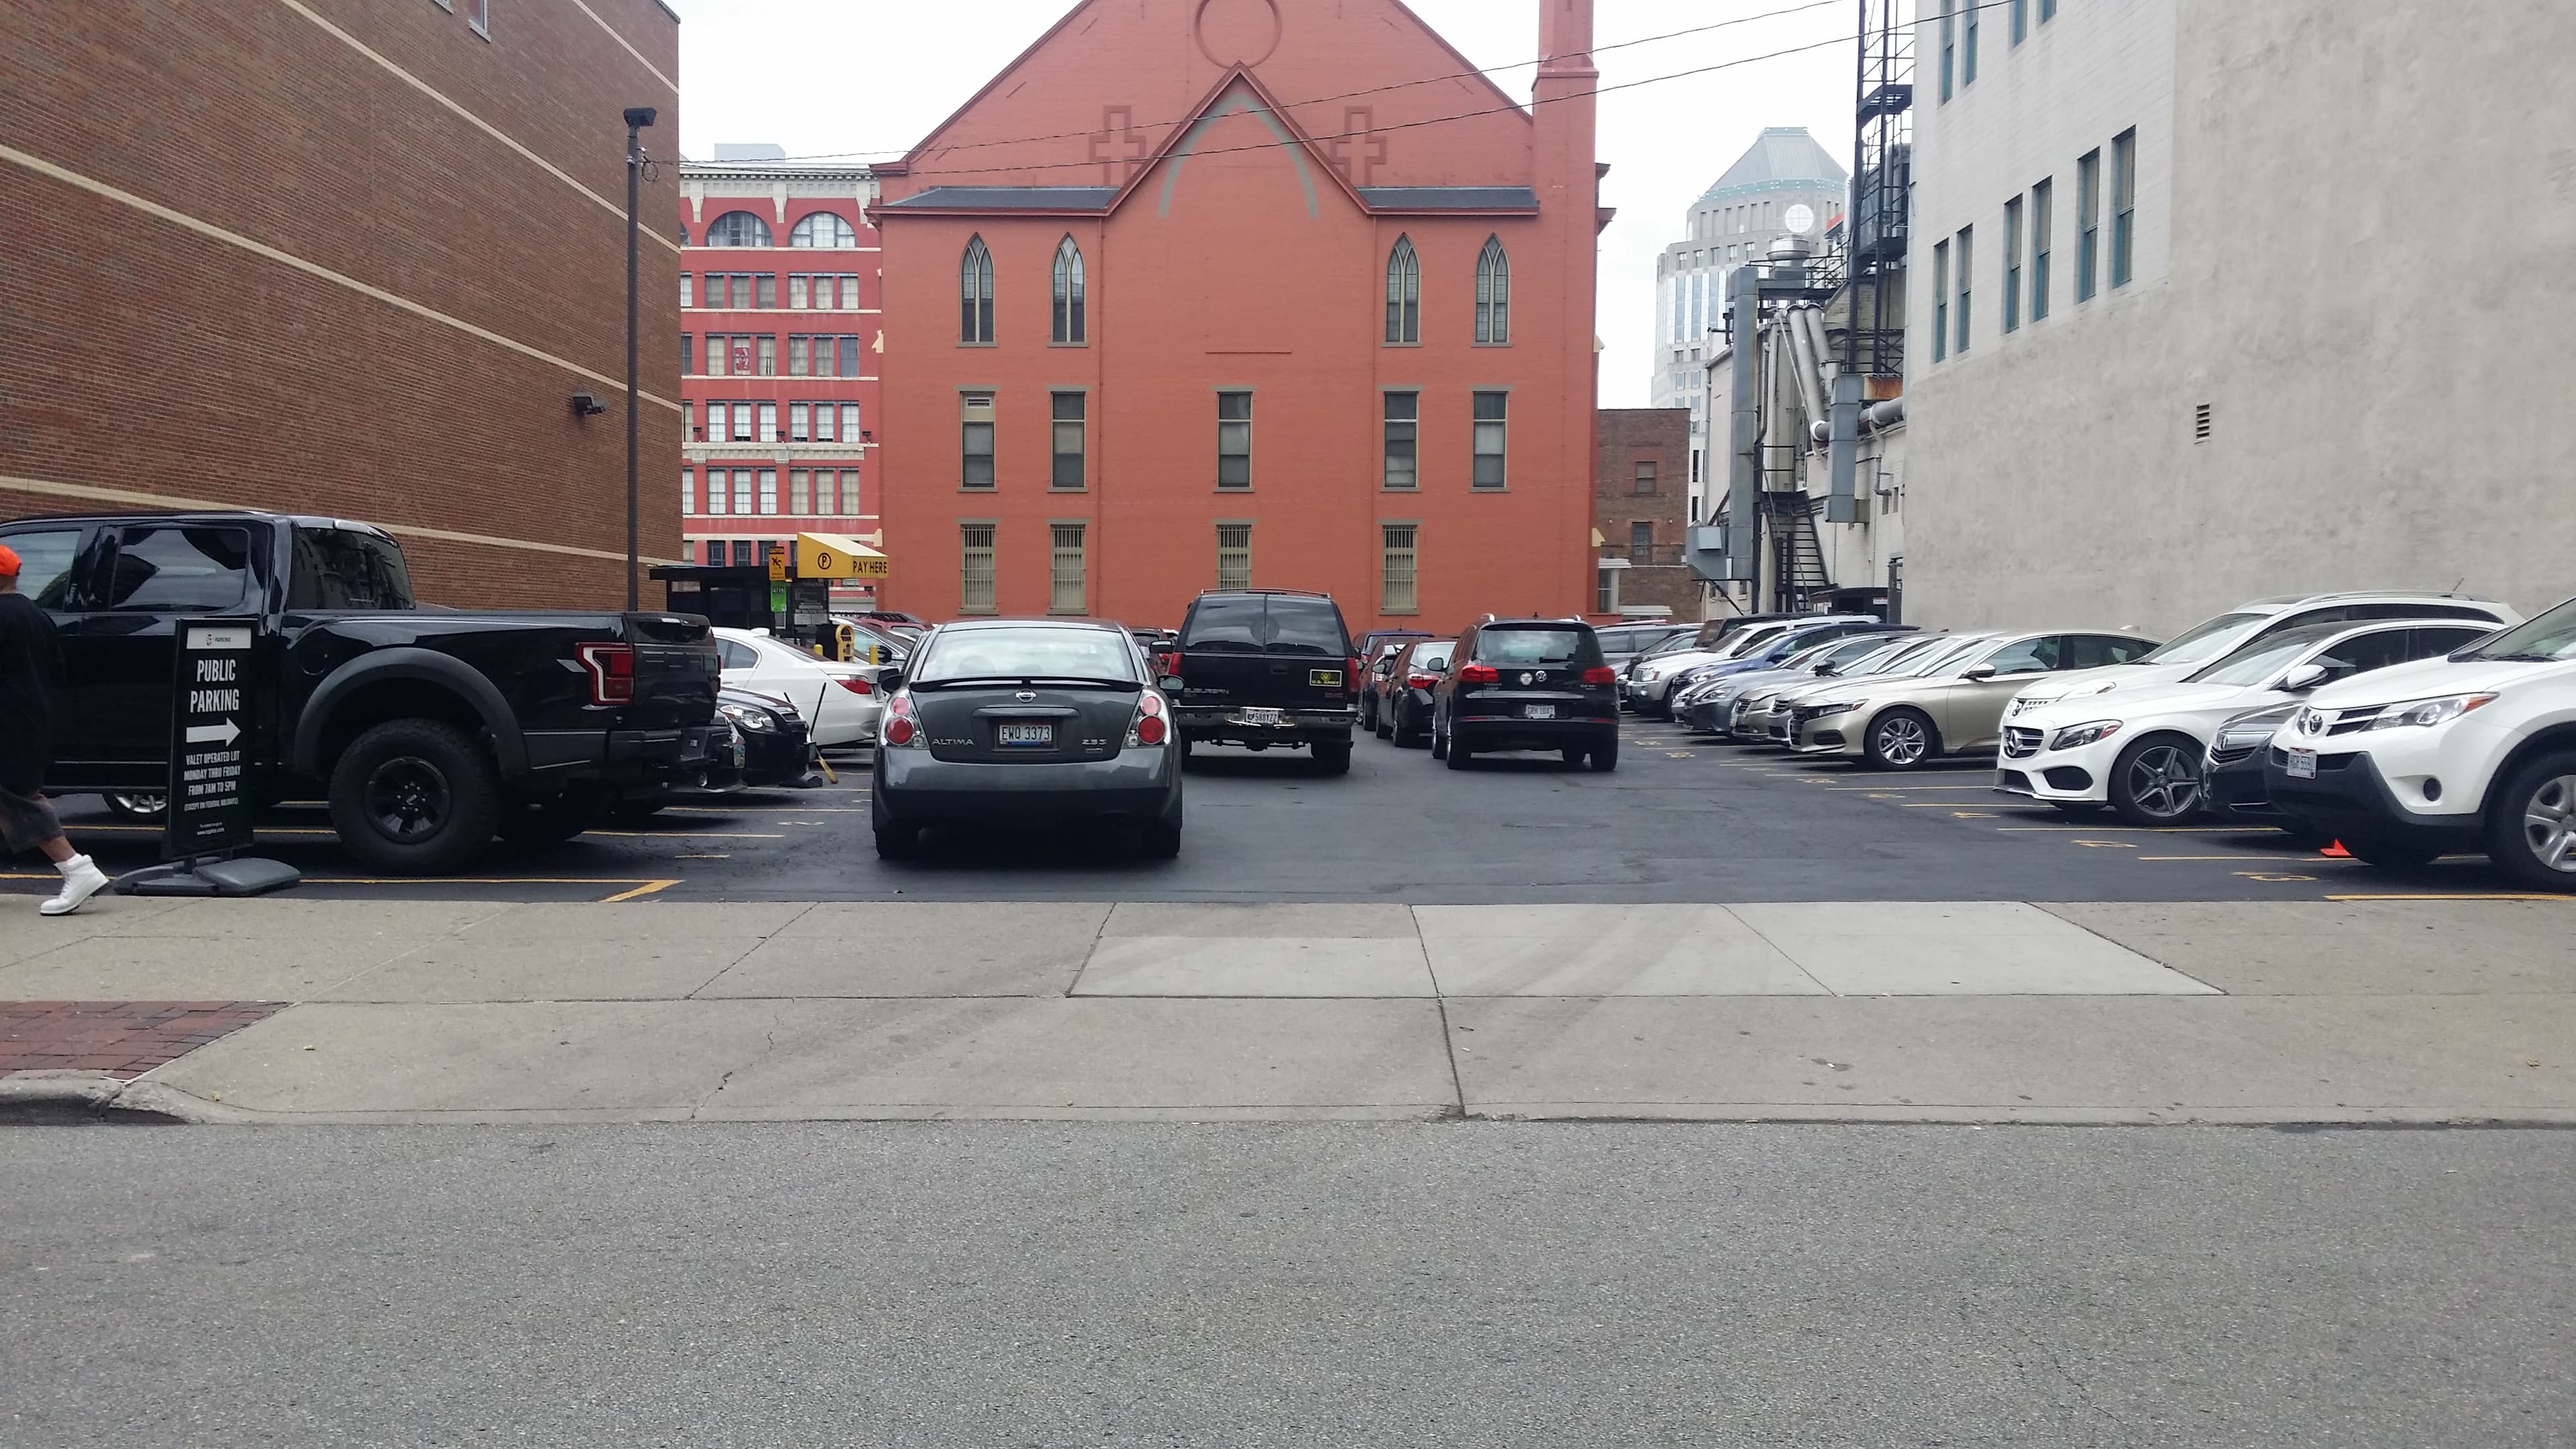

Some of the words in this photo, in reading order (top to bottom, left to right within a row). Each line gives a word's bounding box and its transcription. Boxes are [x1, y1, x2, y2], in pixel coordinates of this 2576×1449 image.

[853, 561, 868, 573] PAY
[869, 561, 888, 574] HERE
[197, 659, 236, 682] PUBLIC
[189, 688, 239, 713] PARKING
[1002, 727, 1020, 740] EWQ
[1024, 727, 1050, 740] 3373
[185, 753, 203, 765] VALET
[203, 751, 230, 764] OPERATED
[230, 750, 240, 761] LOT
[184, 769, 207, 781] MONDAY
[208, 767, 222, 778] THRU
[223, 765, 241, 777] FRIDAY
[188, 784, 204, 796] FROM
[205, 782, 216, 794] 7AM
[217, 782, 224, 792] TO
[225, 780, 236, 792] 5PM
